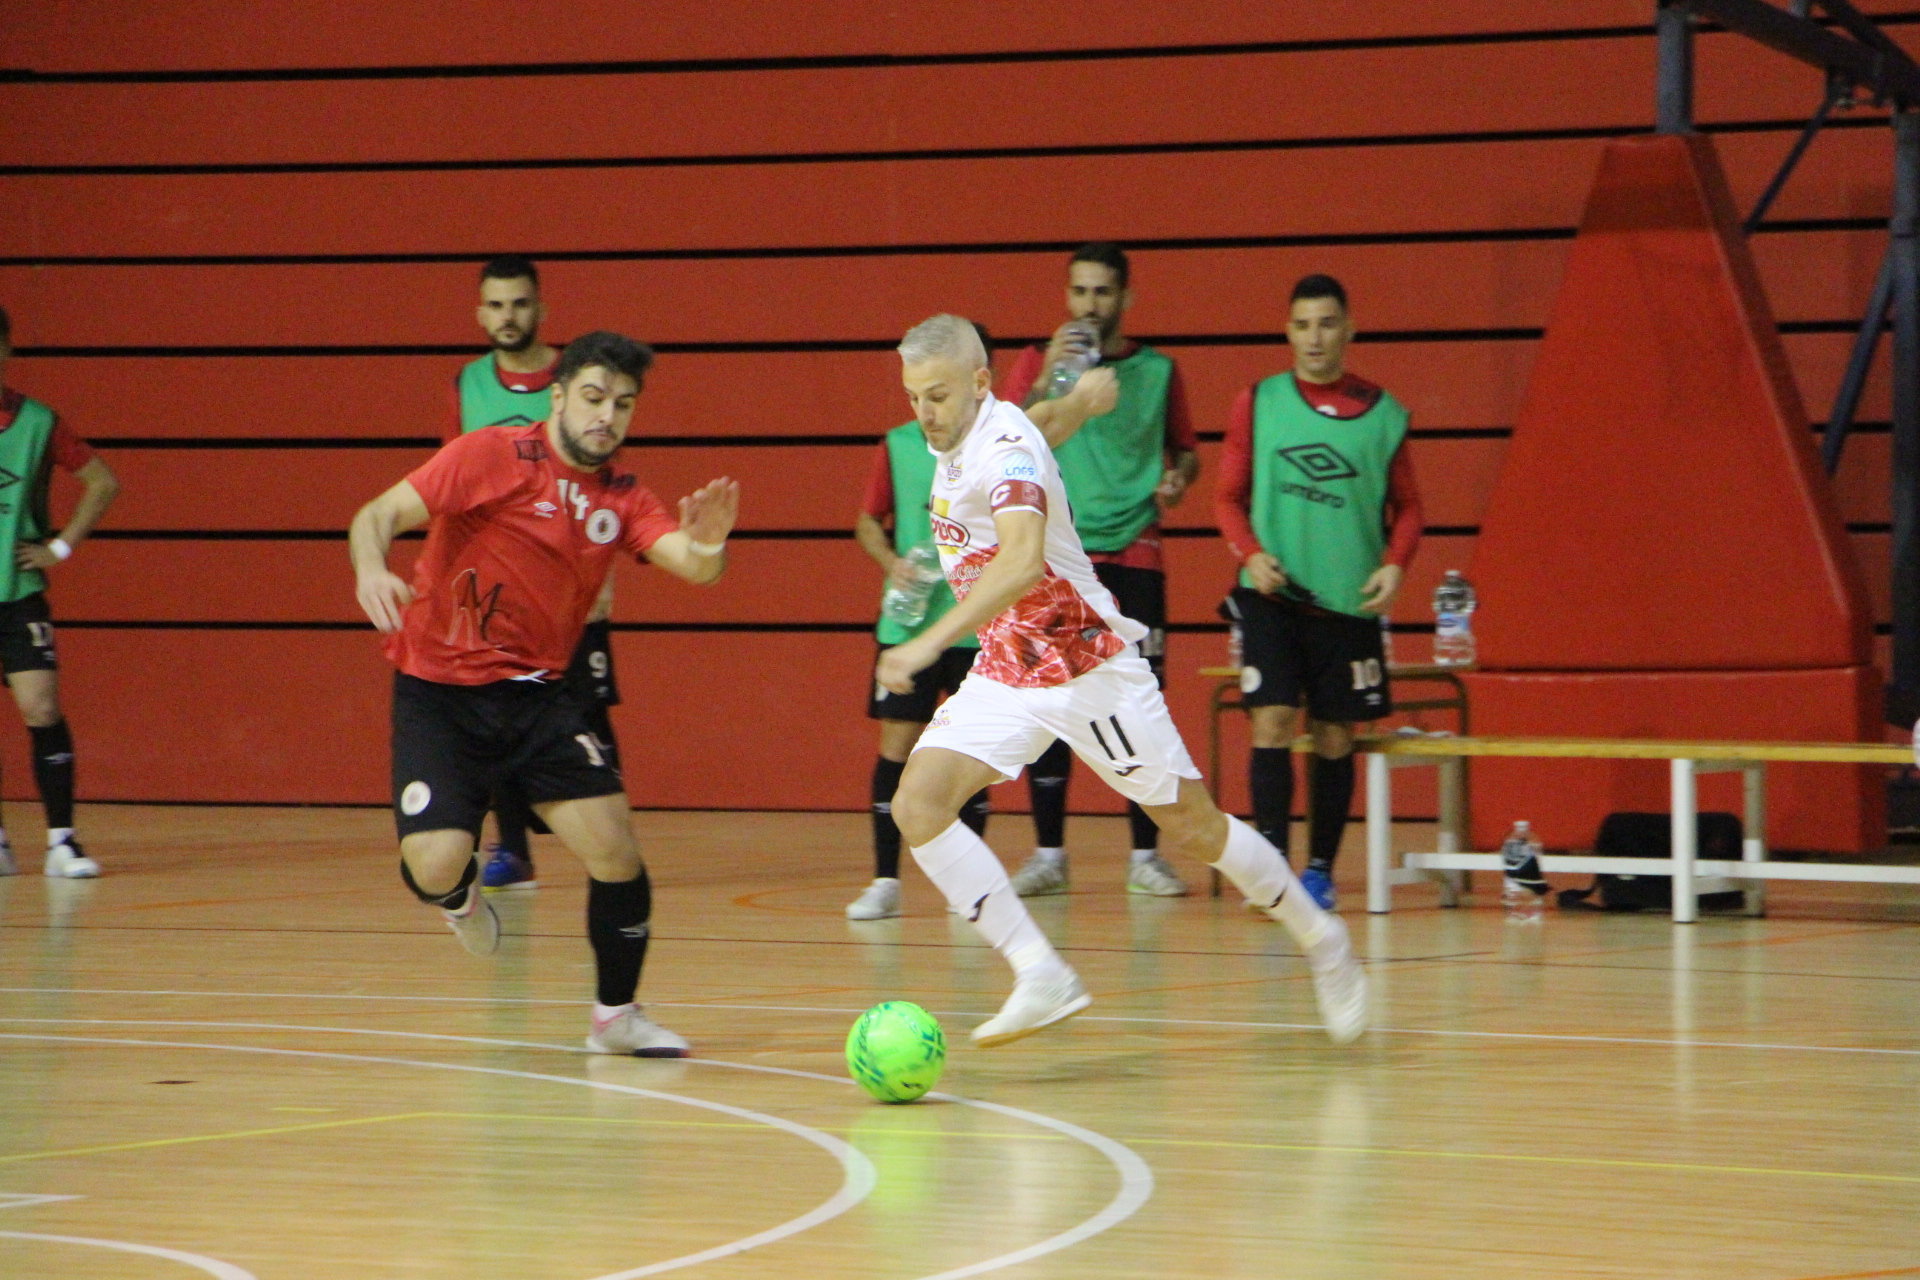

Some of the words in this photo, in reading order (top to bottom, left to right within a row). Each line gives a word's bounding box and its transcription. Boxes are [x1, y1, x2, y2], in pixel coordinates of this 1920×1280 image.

[991, 484, 1011, 507] C
[588, 651, 607, 678] 9
[1350, 657, 1382, 690] 10
[1089, 714, 1135, 761] 11
